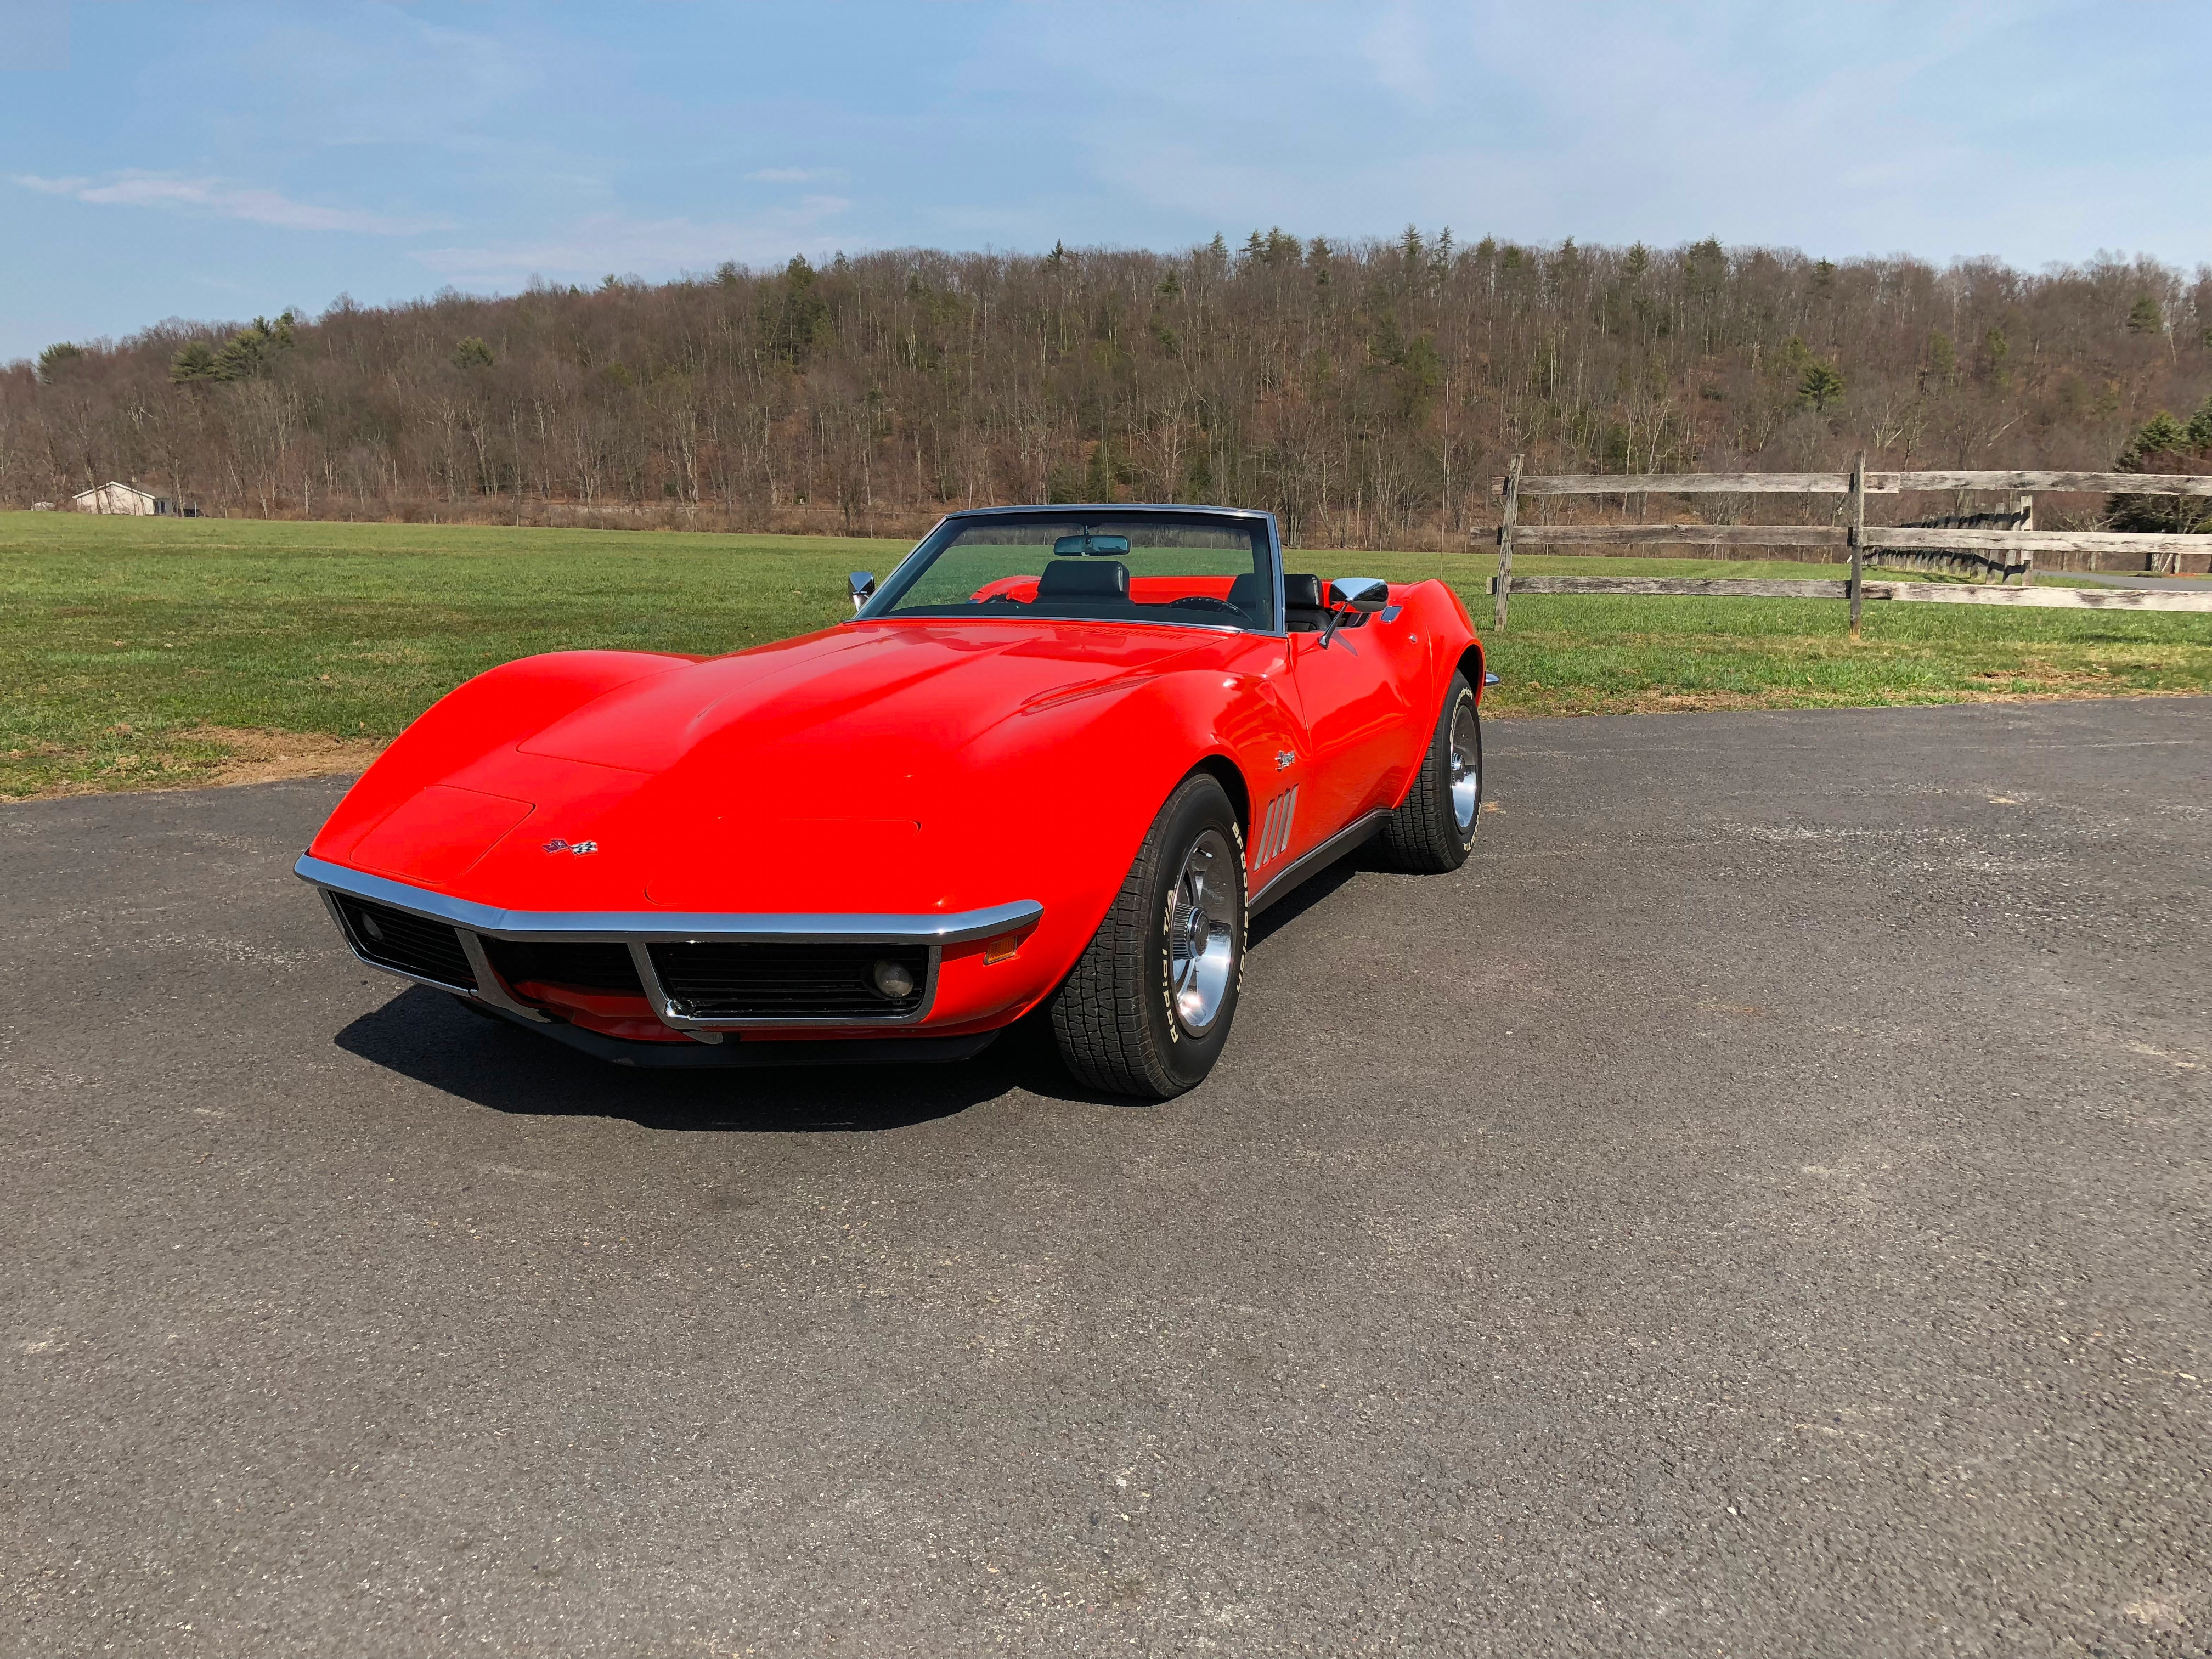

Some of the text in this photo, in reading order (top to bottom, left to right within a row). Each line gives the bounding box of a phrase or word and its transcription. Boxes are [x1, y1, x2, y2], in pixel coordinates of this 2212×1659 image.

[1162, 890, 1178, 1043] Radial T/A
[1232, 821, 1249, 992] BFGoodrich
